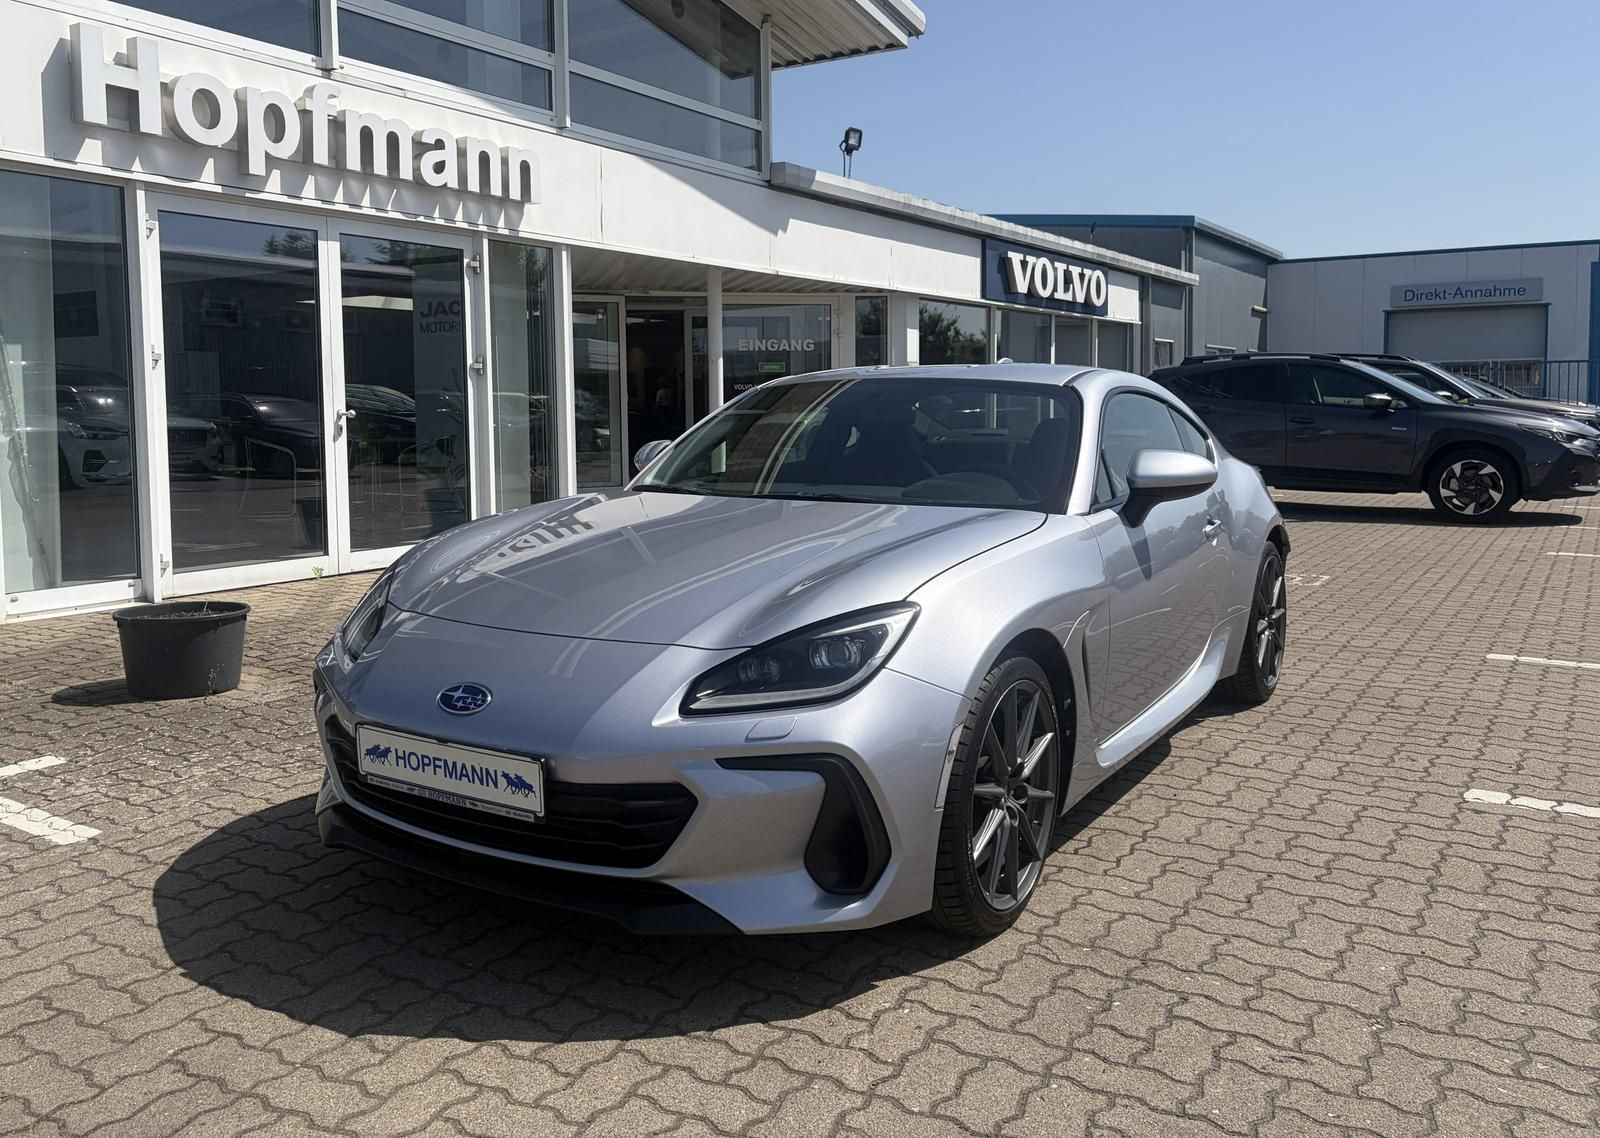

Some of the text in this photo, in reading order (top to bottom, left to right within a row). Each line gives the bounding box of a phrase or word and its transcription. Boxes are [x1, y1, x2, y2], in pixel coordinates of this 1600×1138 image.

[71, 22, 541, 203] Hopfmann
[1006, 250, 1107, 307] VOLVO
[1404, 285, 1527, 302] Direkt-Annahme
[419, 300, 461, 318] JAC
[736, 339, 815, 352] EINGANG
[395, 748, 498, 789] HOPFMANN
